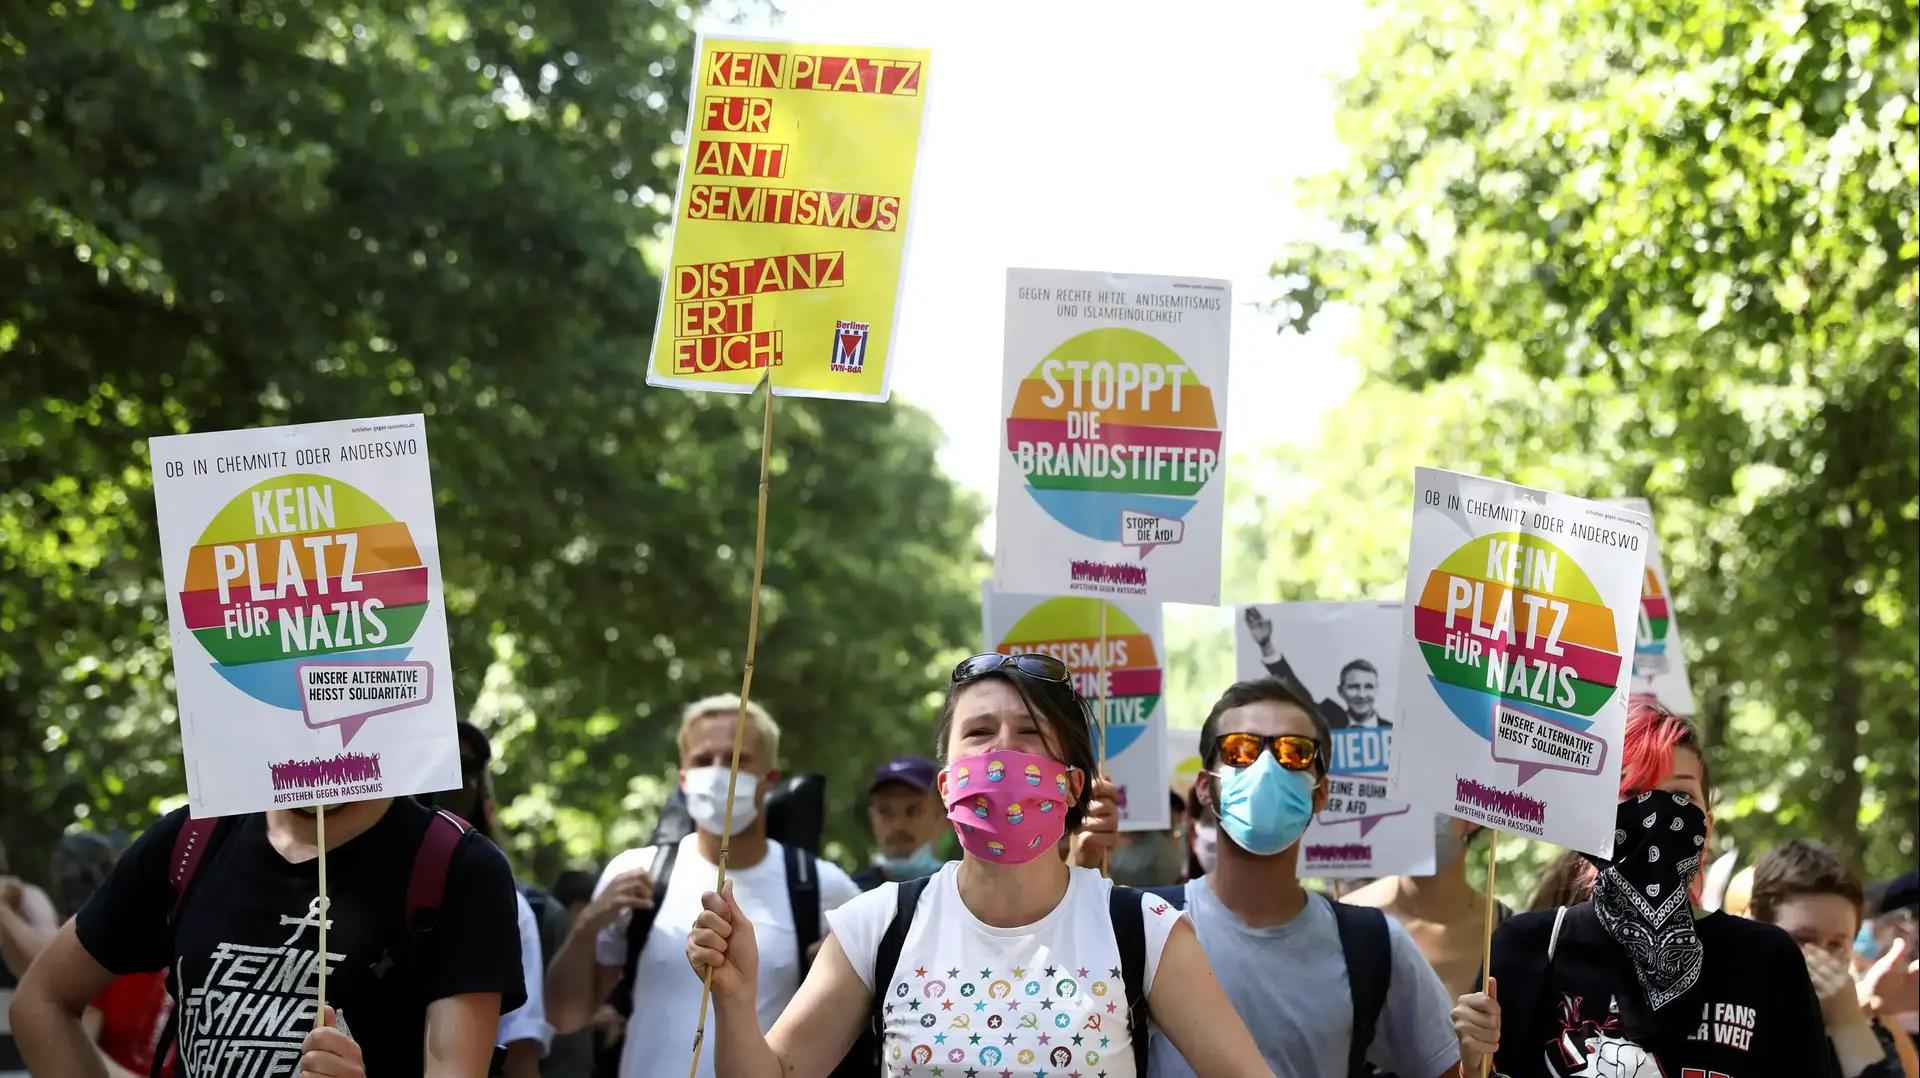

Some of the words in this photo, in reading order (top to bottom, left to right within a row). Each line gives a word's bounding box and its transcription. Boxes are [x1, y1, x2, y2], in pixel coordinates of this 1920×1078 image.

[708, 52, 786, 88] KEIN
[791, 55, 921, 96] PLATZ
[702, 96, 772, 132] FÜR
[695, 141, 789, 178] ANTI
[688, 185, 900, 231] SEMITISMUS
[675, 251, 844, 300] DISTANZ
[675, 297, 753, 337] IERT
[1018, 288, 1050, 301] GEGEN
[1056, 289, 1092, 303] RECHTE
[1135, 294, 1221, 311] ANTISEMITISMUS
[1057, 305, 1078, 317] UND
[1083, 306, 1183, 323] ISLAMFEINDLICHKEIT
[836, 320, 869, 330] Berliner
[674, 331, 783, 374] EUCH!
[830, 364, 862, 373] VVN-BdA
[1040, 359, 1189, 412] STOPPT
[1067, 411, 1100, 440] DIE
[165, 460, 184, 478] OB
[193, 458, 208, 476] IN
[216, 451, 287, 473] CHEMNITZ
[296, 448, 331, 466] ODER
[340, 438, 418, 462] ANDERSWO
[1017, 441, 1217, 483] BRANDSTIFTER
[252, 484, 336, 535] KEIN
[1126, 517, 1160, 529] STOPPT
[1425, 490, 1440, 506] OB
[1448, 494, 1460, 511] IN
[1467, 499, 1527, 527] CHEMNITZ
[1533, 513, 1565, 535] ODER
[1570, 522, 1640, 552] ANDERSWO
[1137, 529, 1151, 541] DIE
[1154, 529, 1173, 541] AfD!
[214, 533, 363, 604] PLATZ
[1486, 538, 1558, 593] KEIN
[224, 602, 271, 639] FÜR
[278, 598, 388, 653] NAZIS
[1445, 576, 1570, 657] PLATZ
[309, 672, 348, 685] UNSERE
[352, 670, 418, 684] ALTERNATIVE
[1072, 670, 1114, 696] EINE
[1444, 631, 1483, 668] FÜR
[1486, 648, 1579, 709] NAZIS
[309, 687, 345, 701] HEISST
[349, 684, 418, 700] SOLIDARITÄT!
[1499, 726, 1529, 745] HEISST
[1531, 737, 1590, 768] SOLIDARITÄT!
[1501, 712, 1535, 733] UNSERE
[1537, 725, 1594, 754] ALTERNATIVE
[274, 790, 314, 804] AUFSTEHEN
[316, 787, 340, 801] GEGEN
[341, 783, 383, 797] RASSISMUS
[1454, 804, 1485, 821] AUFSTEHEN
[1487, 813, 1507, 827] GEGEN
[1508, 818, 1544, 836] RASSISMUS
[1714, 1003, 1756, 1029] FANS
[1714, 1023, 1754, 1051] WELT
